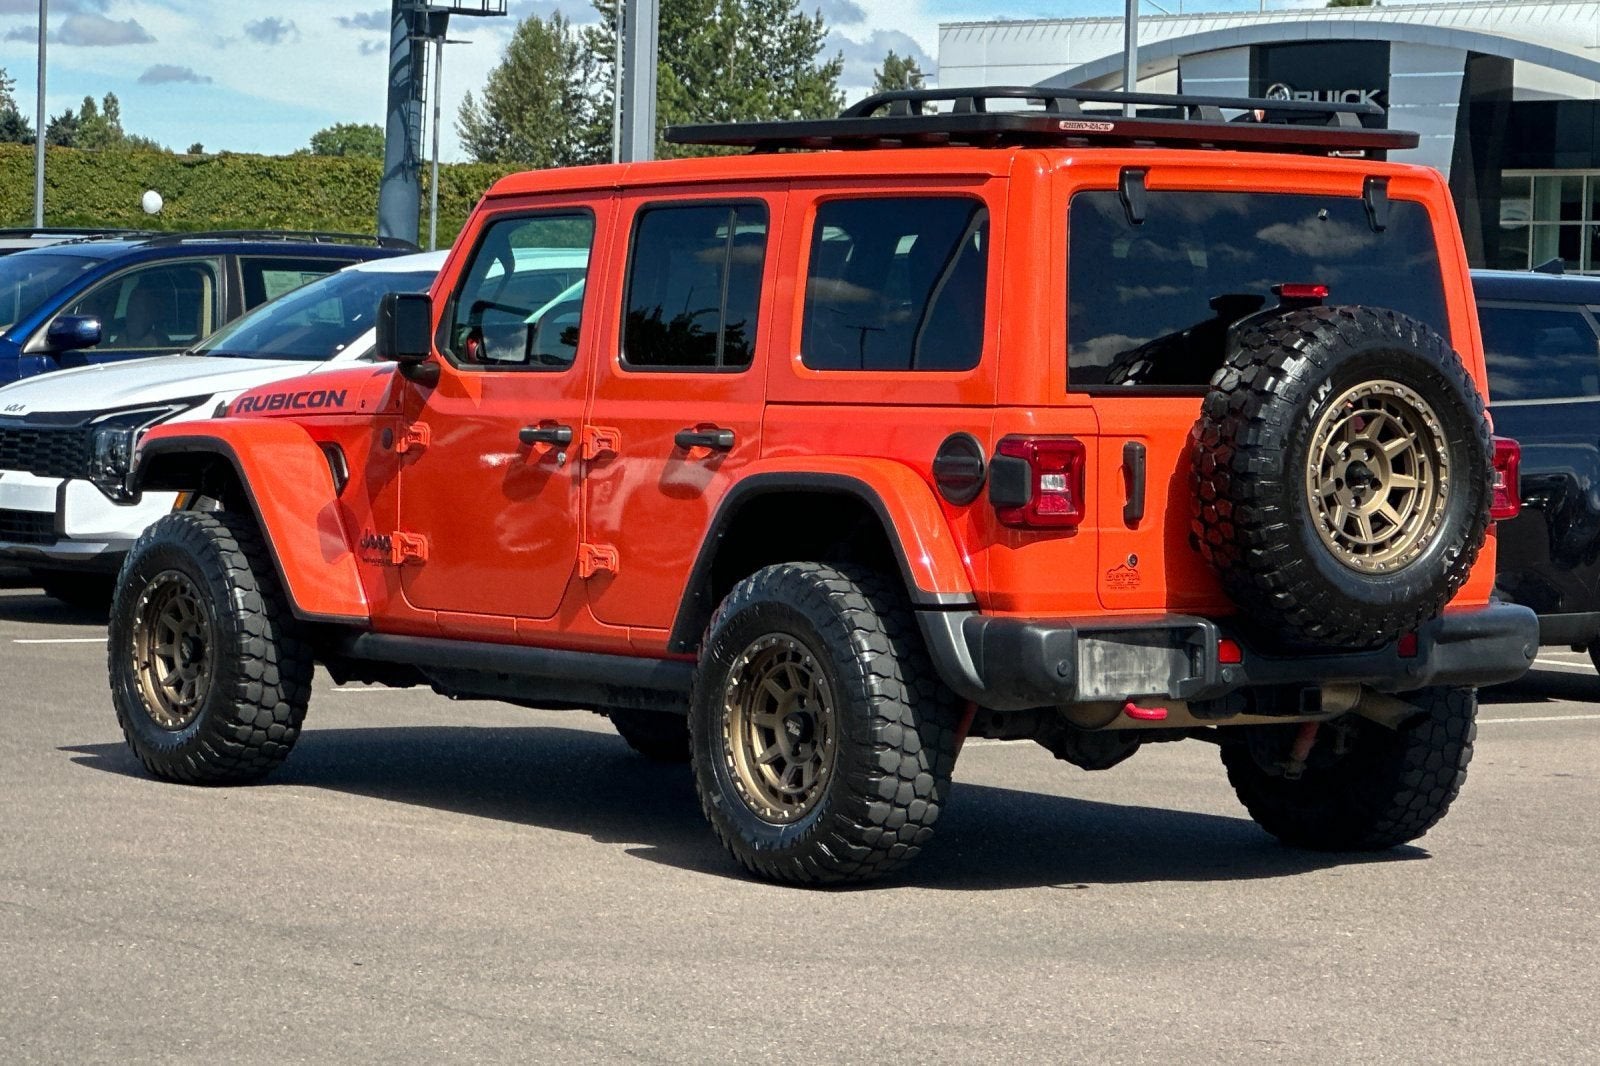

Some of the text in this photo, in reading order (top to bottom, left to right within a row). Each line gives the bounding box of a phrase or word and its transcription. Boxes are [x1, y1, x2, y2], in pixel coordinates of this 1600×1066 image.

[1293, 89, 1382, 104] BUICK
[1063, 122, 1111, 130] RHINO-RACK
[235, 389, 348, 414] RUBICON
